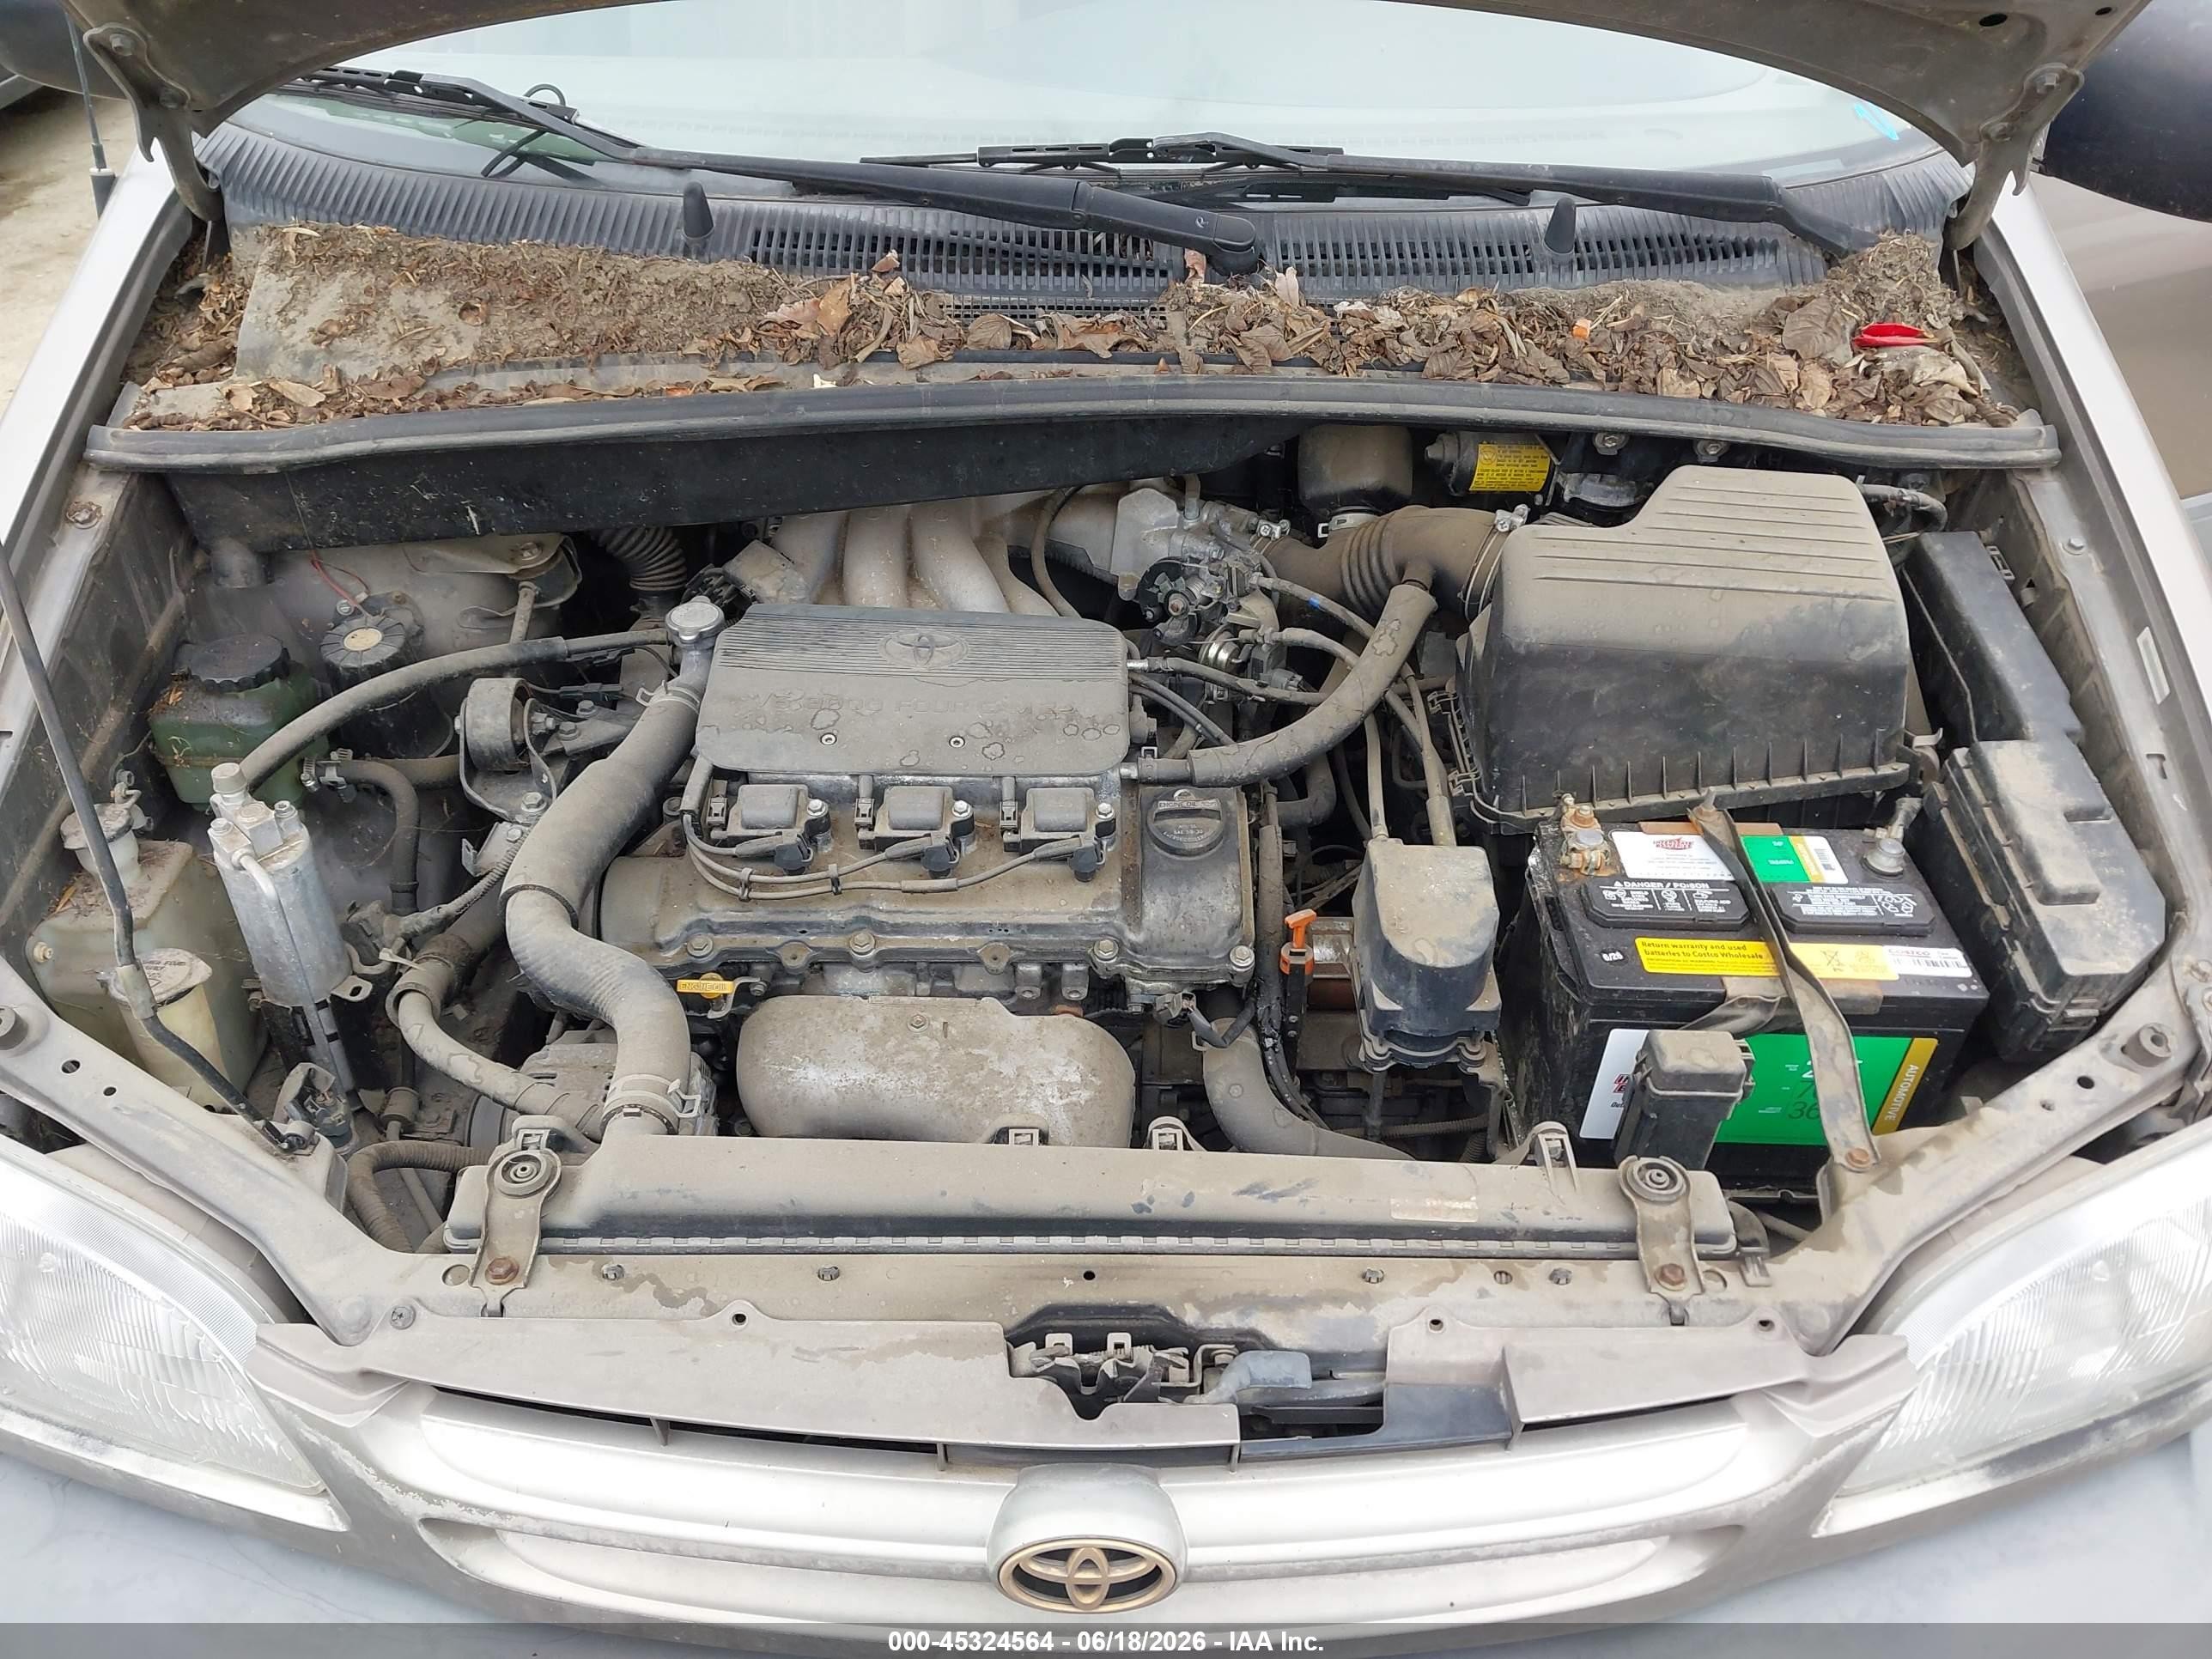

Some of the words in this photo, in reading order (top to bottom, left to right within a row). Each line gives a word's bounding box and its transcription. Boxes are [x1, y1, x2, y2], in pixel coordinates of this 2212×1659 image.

[1641, 940, 1670, 949] Return
[1672, 942, 1708, 951] warranty
[1721, 951, 1764, 960] Wholesale
[679, 981, 713, 991] ENGINE
[714, 982, 727, 991] OIL
[1884, 1064, 1919, 1121] AUTOMOTIVE
